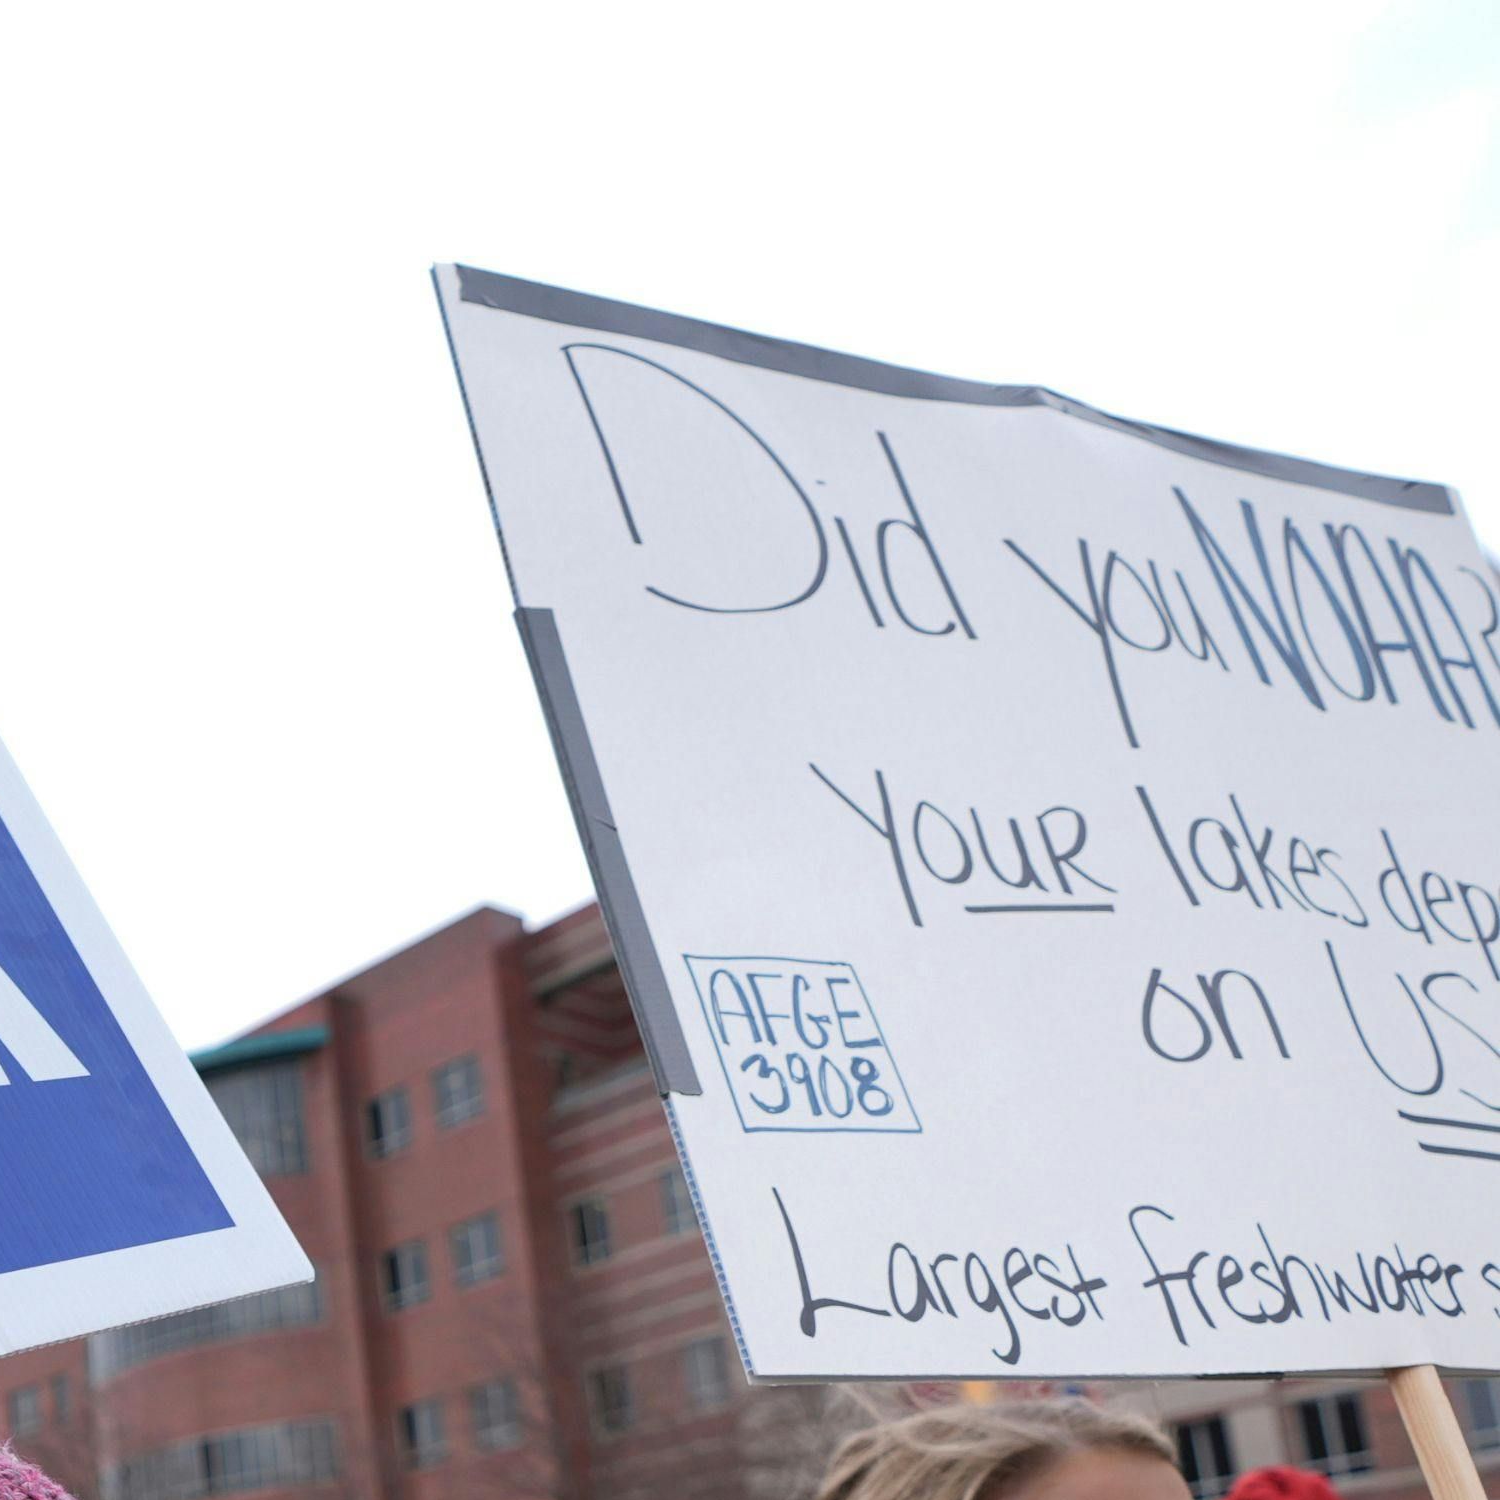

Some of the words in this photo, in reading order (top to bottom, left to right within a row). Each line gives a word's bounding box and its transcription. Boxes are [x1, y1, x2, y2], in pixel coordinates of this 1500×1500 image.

[561, 343, 978, 640] Did
[1003, 538, 1230, 748] you
[1135, 786, 1368, 928] lakes
[709, 969, 884, 1051] AFGE
[1141, 967, 1291, 1062] on
[741, 1052, 894, 1119] 3908
[772, 1187, 1108, 1366] Largest
[1129, 1205, 1465, 1346] freshwater
